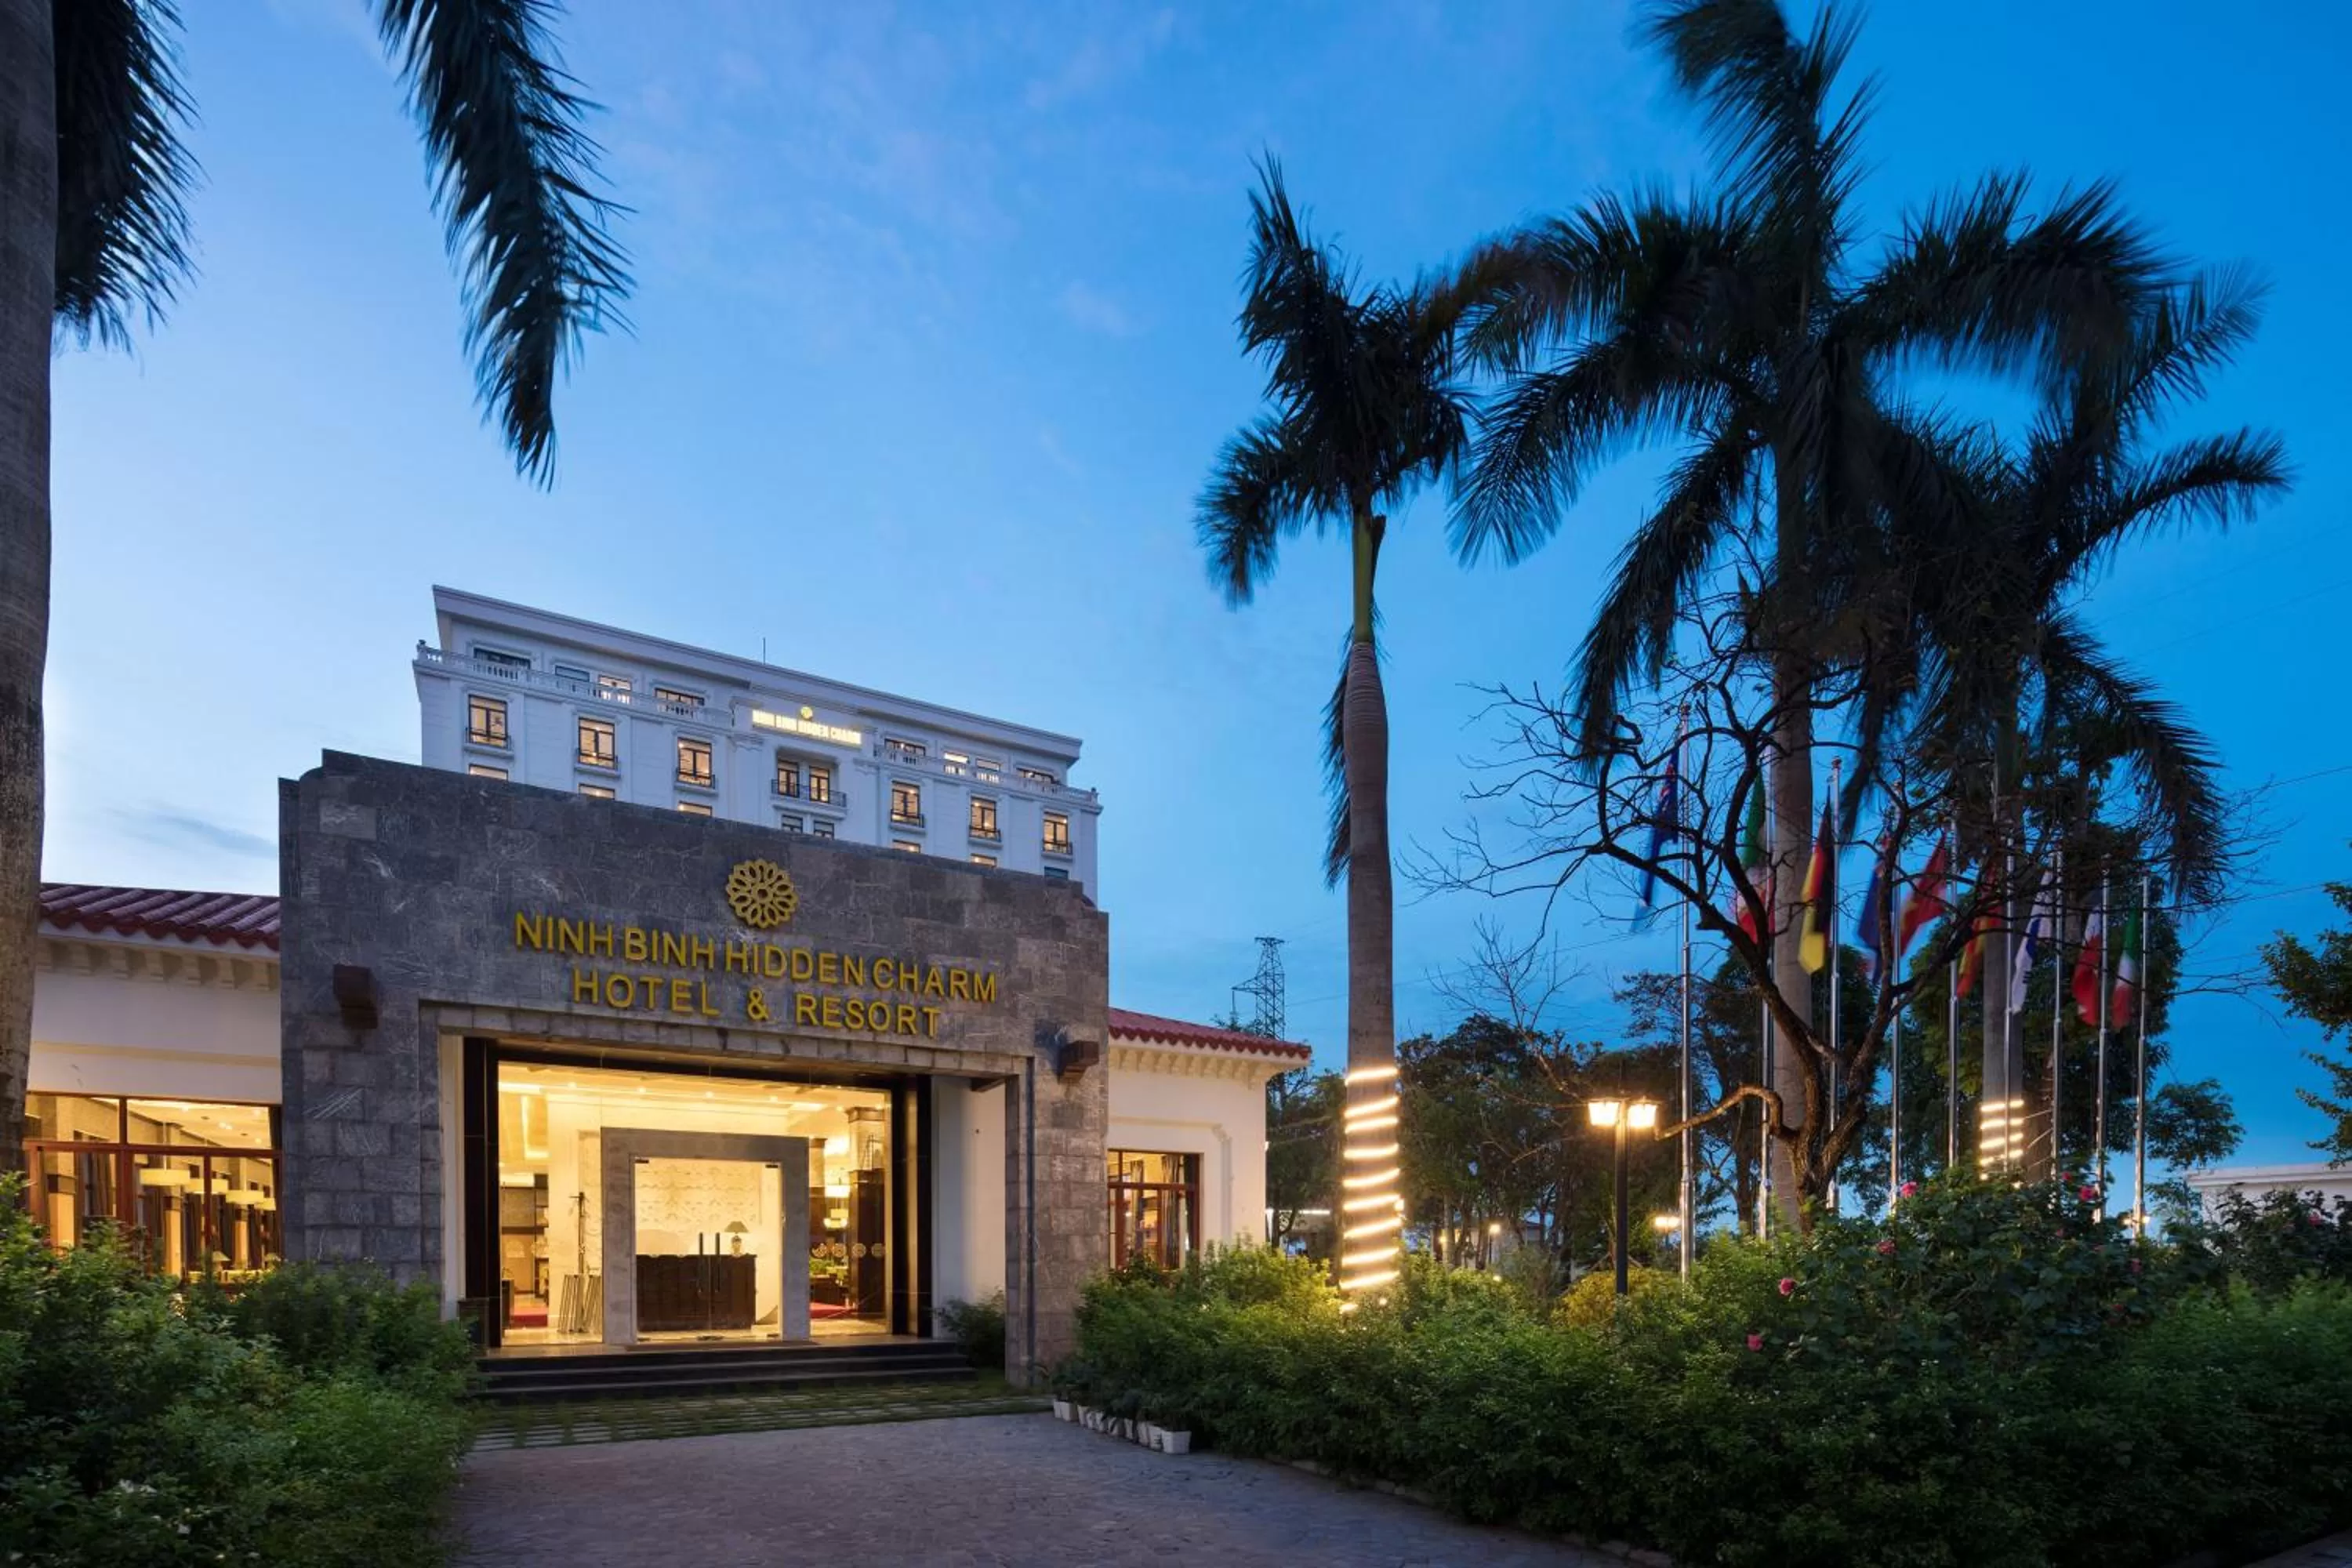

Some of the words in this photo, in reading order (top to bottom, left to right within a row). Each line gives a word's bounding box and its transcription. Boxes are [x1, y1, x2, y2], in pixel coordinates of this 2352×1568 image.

[514, 911, 615, 958] NINH
[622, 927, 715, 970] BINH
[724, 941, 866, 988] HIDDEN
[872, 956, 998, 1004] CHARM
[572, 967, 720, 1018] HOTEL
[746, 987, 771, 1022] &
[794, 991, 943, 1039] RESORT
